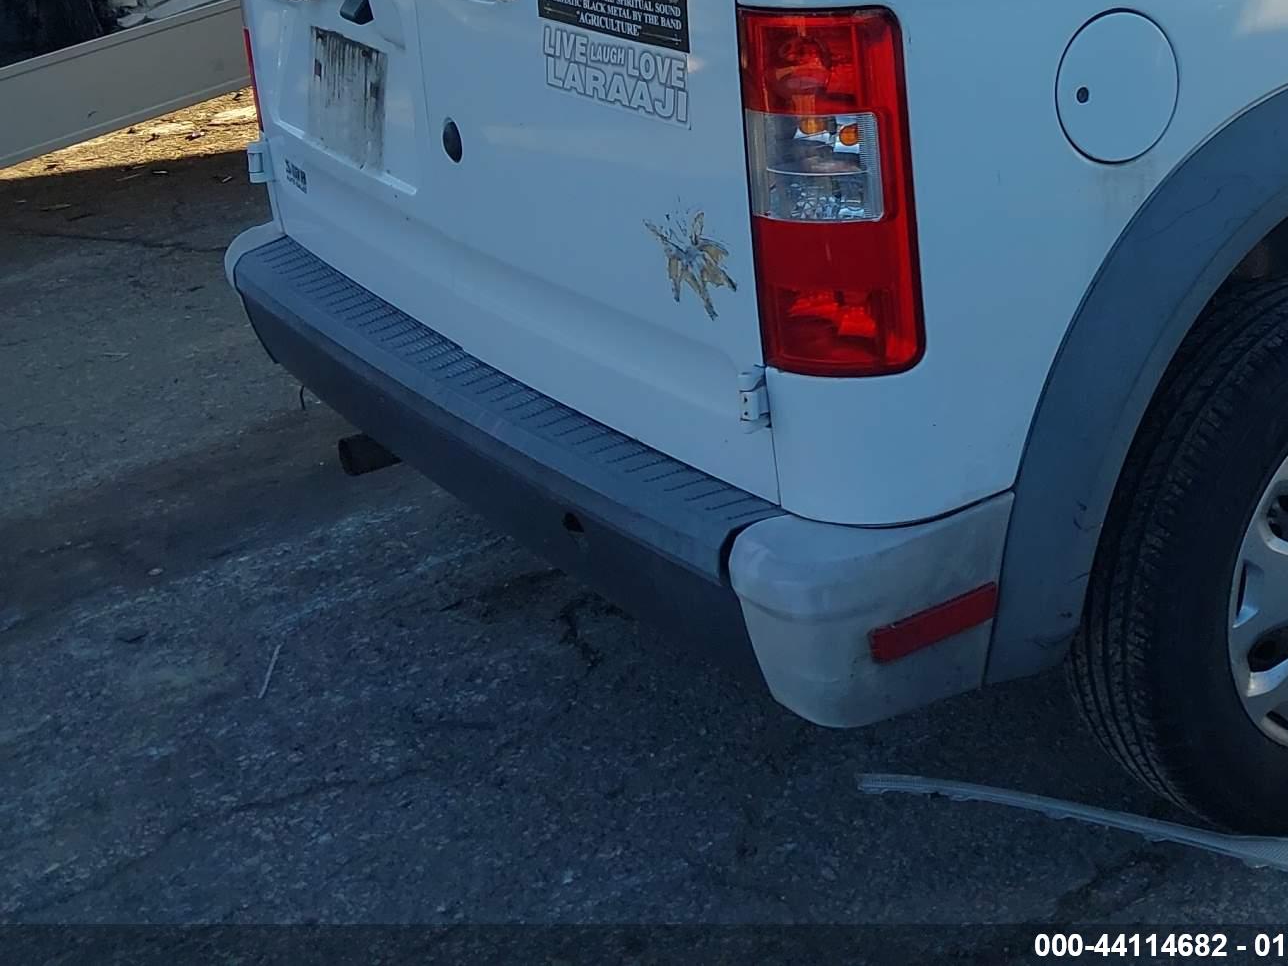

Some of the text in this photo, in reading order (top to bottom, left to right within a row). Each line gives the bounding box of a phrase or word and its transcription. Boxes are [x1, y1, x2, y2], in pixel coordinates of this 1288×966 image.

[607, 5, 631, 19] METAL
[632, 11, 642, 22] BY
[644, 14, 659, 26] THE
[660, 17, 682, 31] BAND
[655, 3, 681, 17] SOUND
[544, 26, 686, 88] LIVE LAUGH LOVE
[546, 56, 688, 122] LARAAJI
